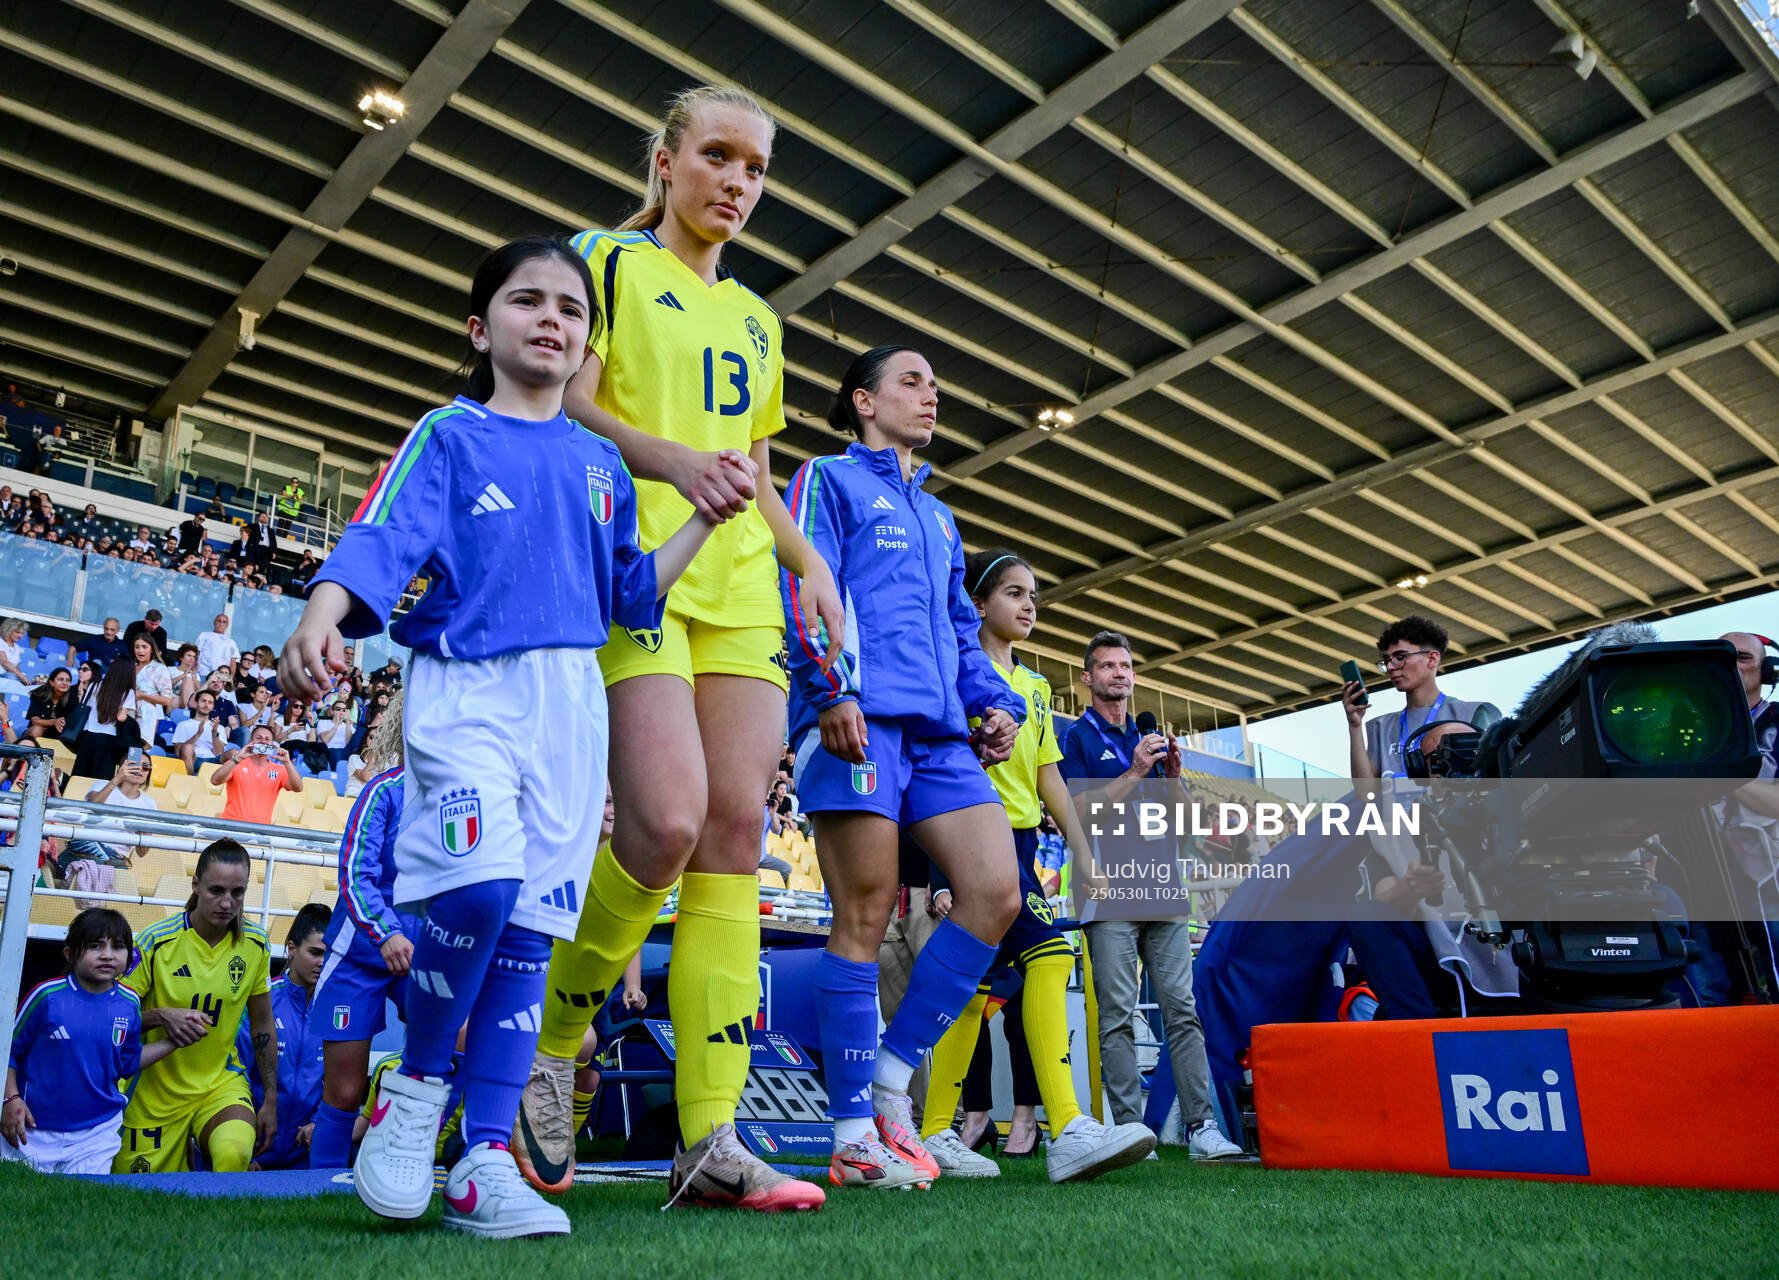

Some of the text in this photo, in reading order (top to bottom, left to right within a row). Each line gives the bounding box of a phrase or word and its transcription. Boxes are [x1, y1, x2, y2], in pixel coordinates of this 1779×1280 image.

[703, 347, 751, 416] 13
[589, 477, 611, 492] ITALIA
[887, 526, 906, 536] TIM
[876, 539, 909, 549] Poste
[444, 803, 476, 819] ITALIA
[425, 915, 475, 950] TALIA
[1591, 948, 1631, 957] Vinten
[844, 1048, 878, 1061] ITAL
[1450, 1069, 1567, 1132] Rai
